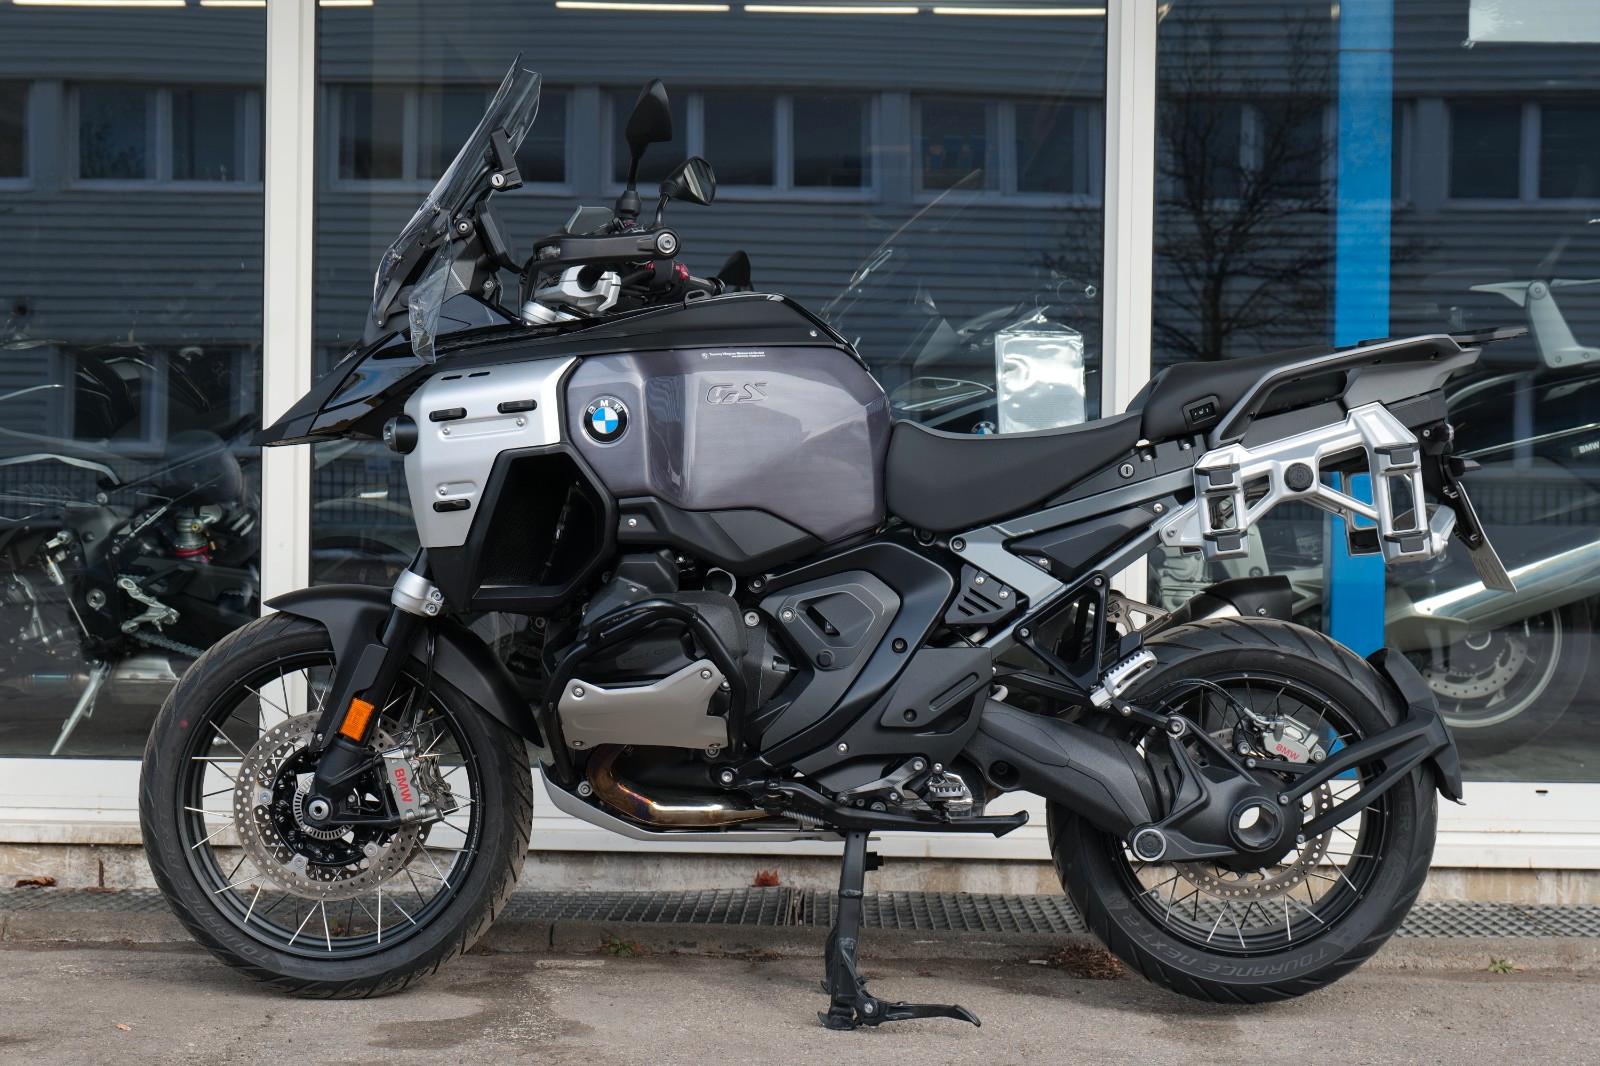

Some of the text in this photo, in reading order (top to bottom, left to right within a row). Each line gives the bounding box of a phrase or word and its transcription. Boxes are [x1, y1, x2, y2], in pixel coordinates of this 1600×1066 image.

[588, 400, 623, 414] BMW
[1275, 743, 1299, 760] BMW
[394, 768, 412, 802] BMW
[1137, 932, 1199, 966] NEXT
[1201, 946, 1329, 977] TOURANCE
